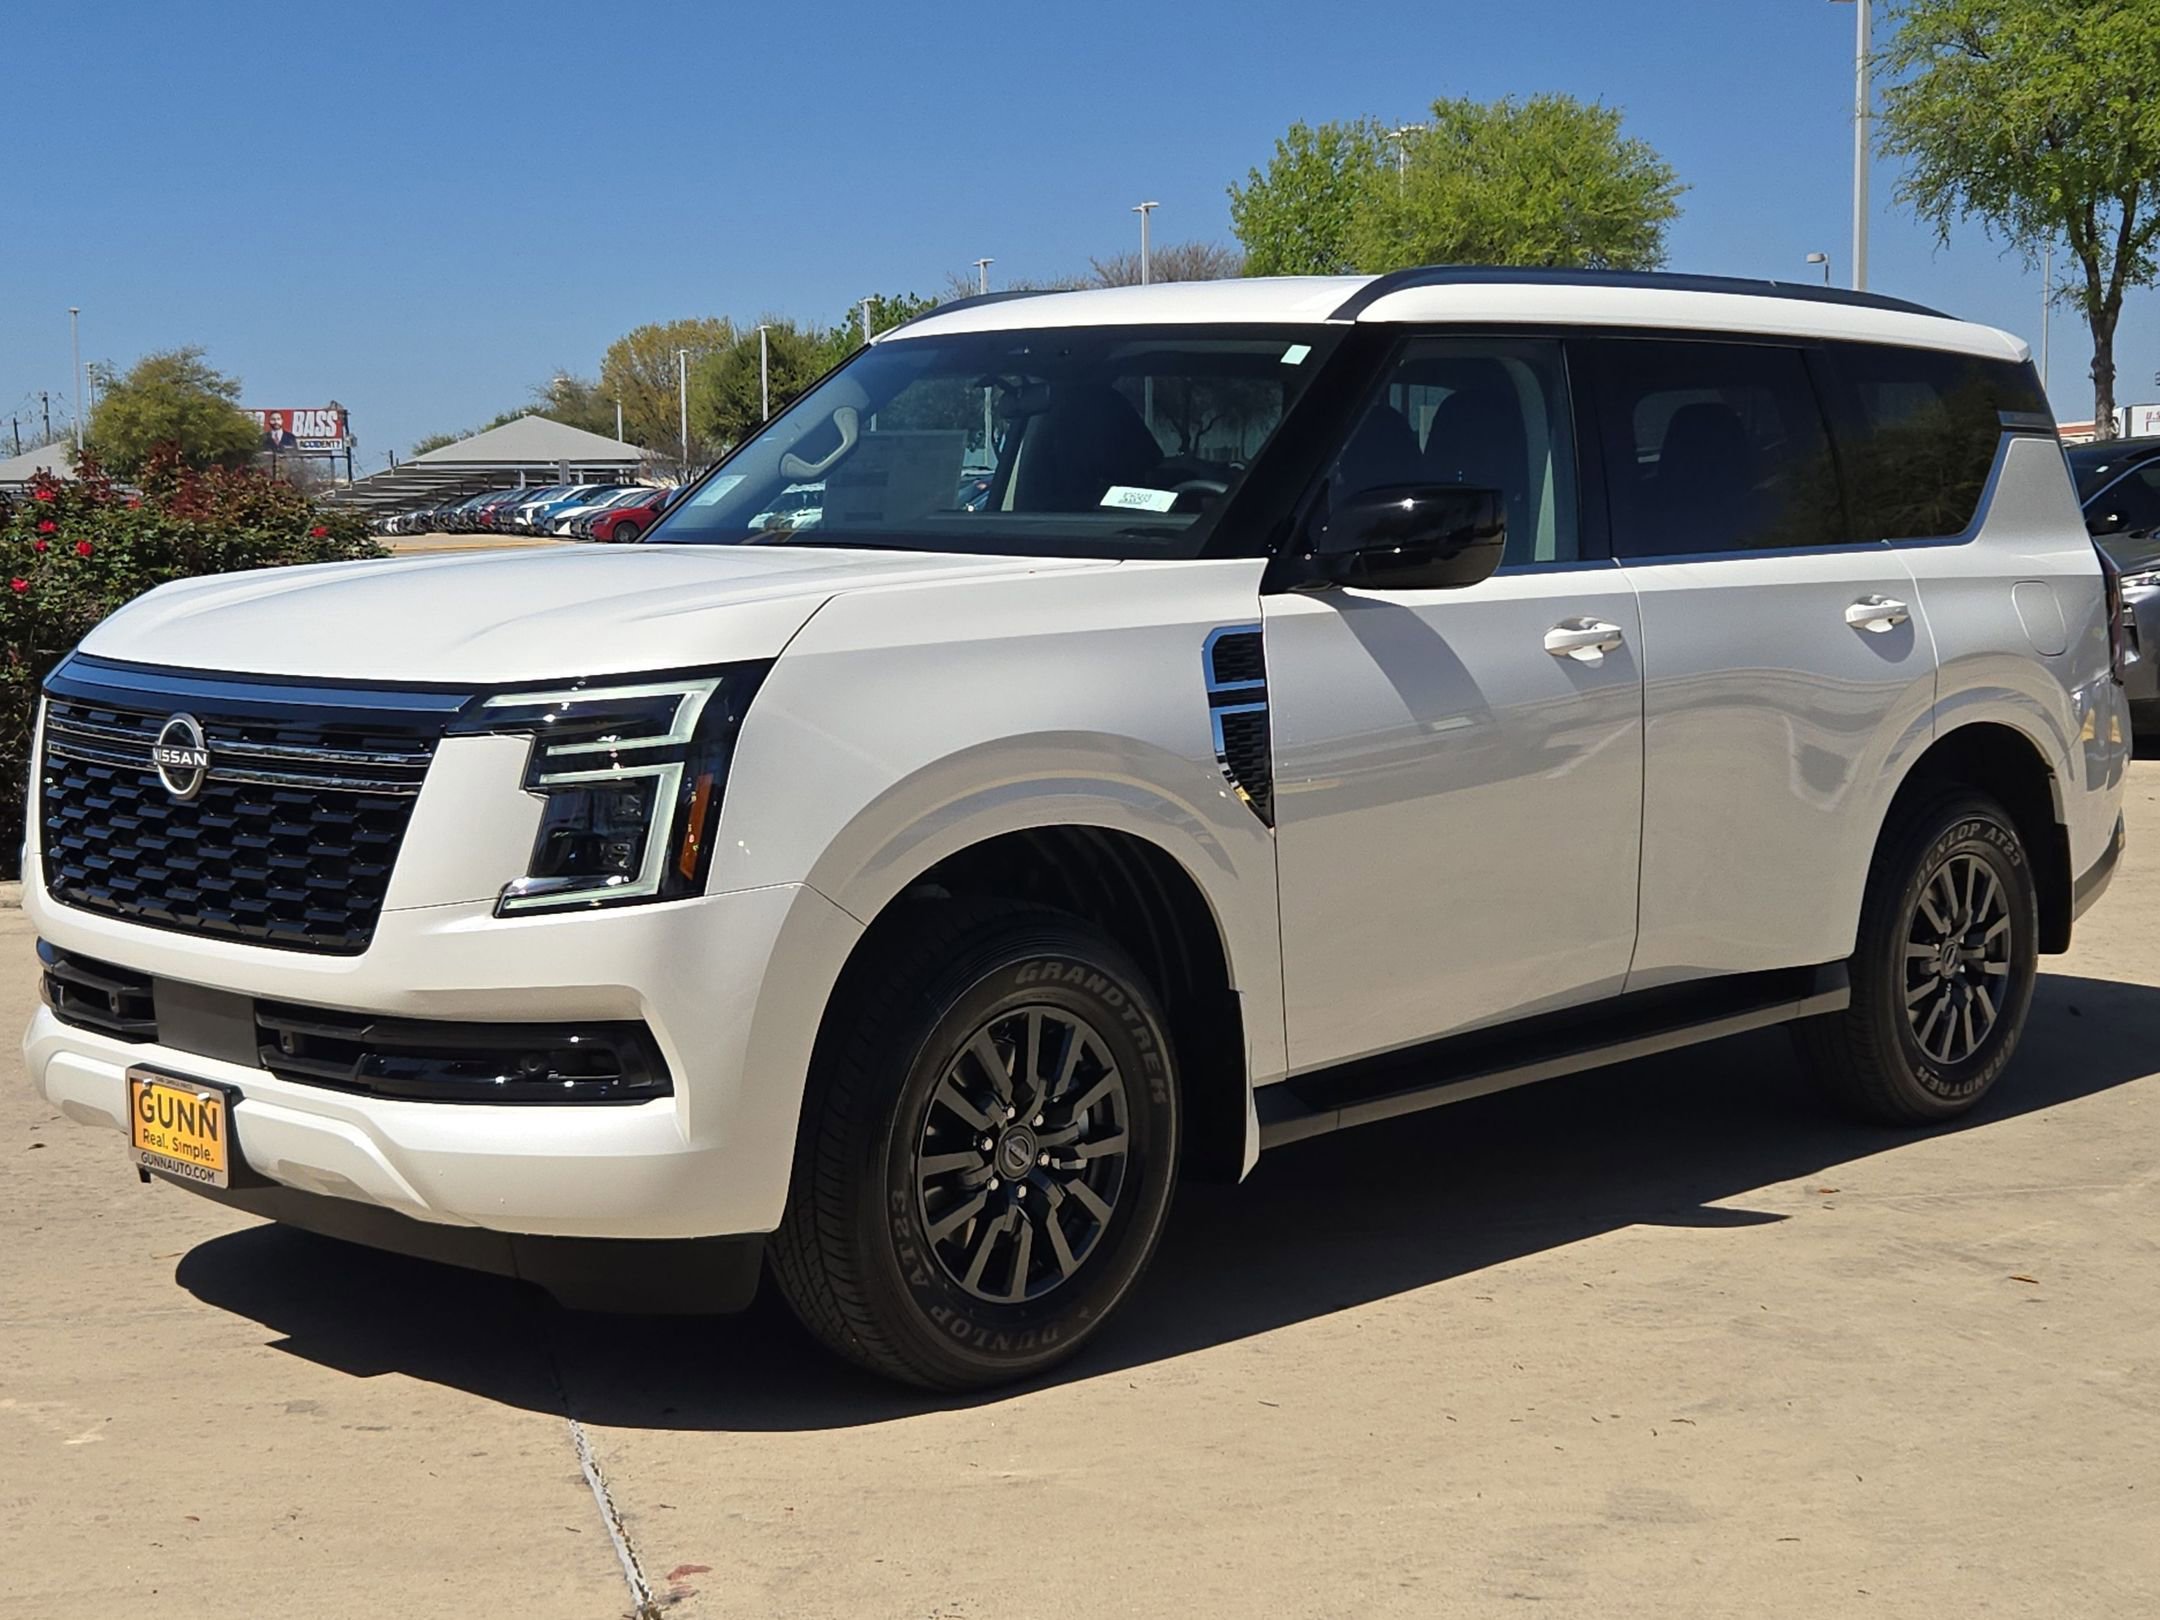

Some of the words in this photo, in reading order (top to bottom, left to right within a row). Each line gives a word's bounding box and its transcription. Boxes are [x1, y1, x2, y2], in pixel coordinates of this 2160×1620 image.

[292, 411, 338, 437] BASS
[152, 747, 207, 766] NISSAN
[1984, 826, 2021, 867] AT23
[1016, 961, 1168, 1104] GRANDTREK
[139, 1089, 218, 1142] GUNN
[143, 1128, 169, 1150] Real.
[172, 1137, 215, 1162] Simple.
[141, 1152, 215, 1183] GUNNAUTO.COM
[929, 1305, 1061, 1352] DUNLOP
